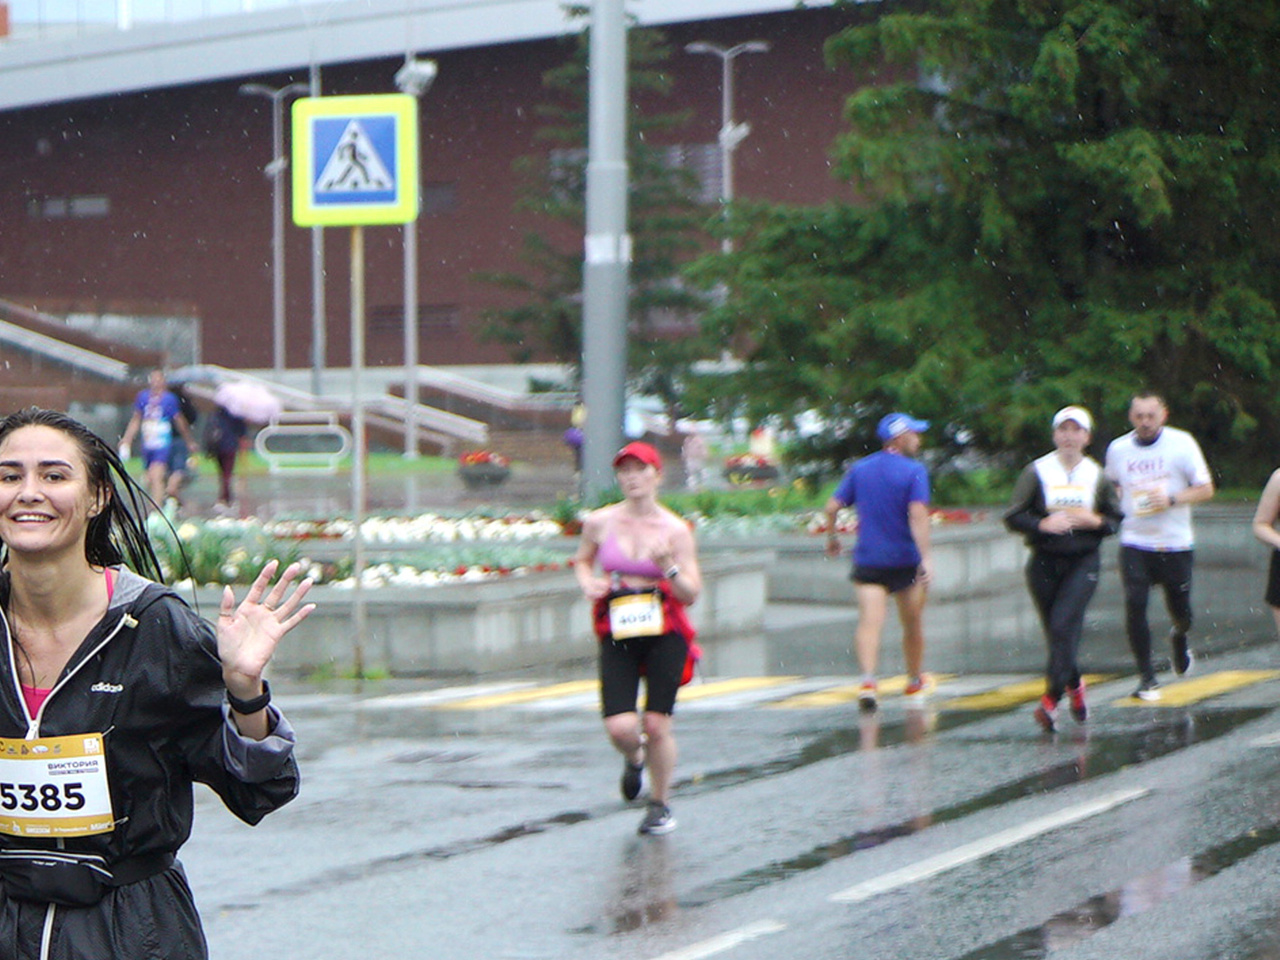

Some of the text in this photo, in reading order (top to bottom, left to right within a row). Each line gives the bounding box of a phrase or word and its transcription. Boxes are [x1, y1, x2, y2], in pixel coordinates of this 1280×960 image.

[91, 682, 123, 693] adidas
[47, 760, 99, 770] ВИКТОРИЯ
[0, 782, 85, 811] 5385
